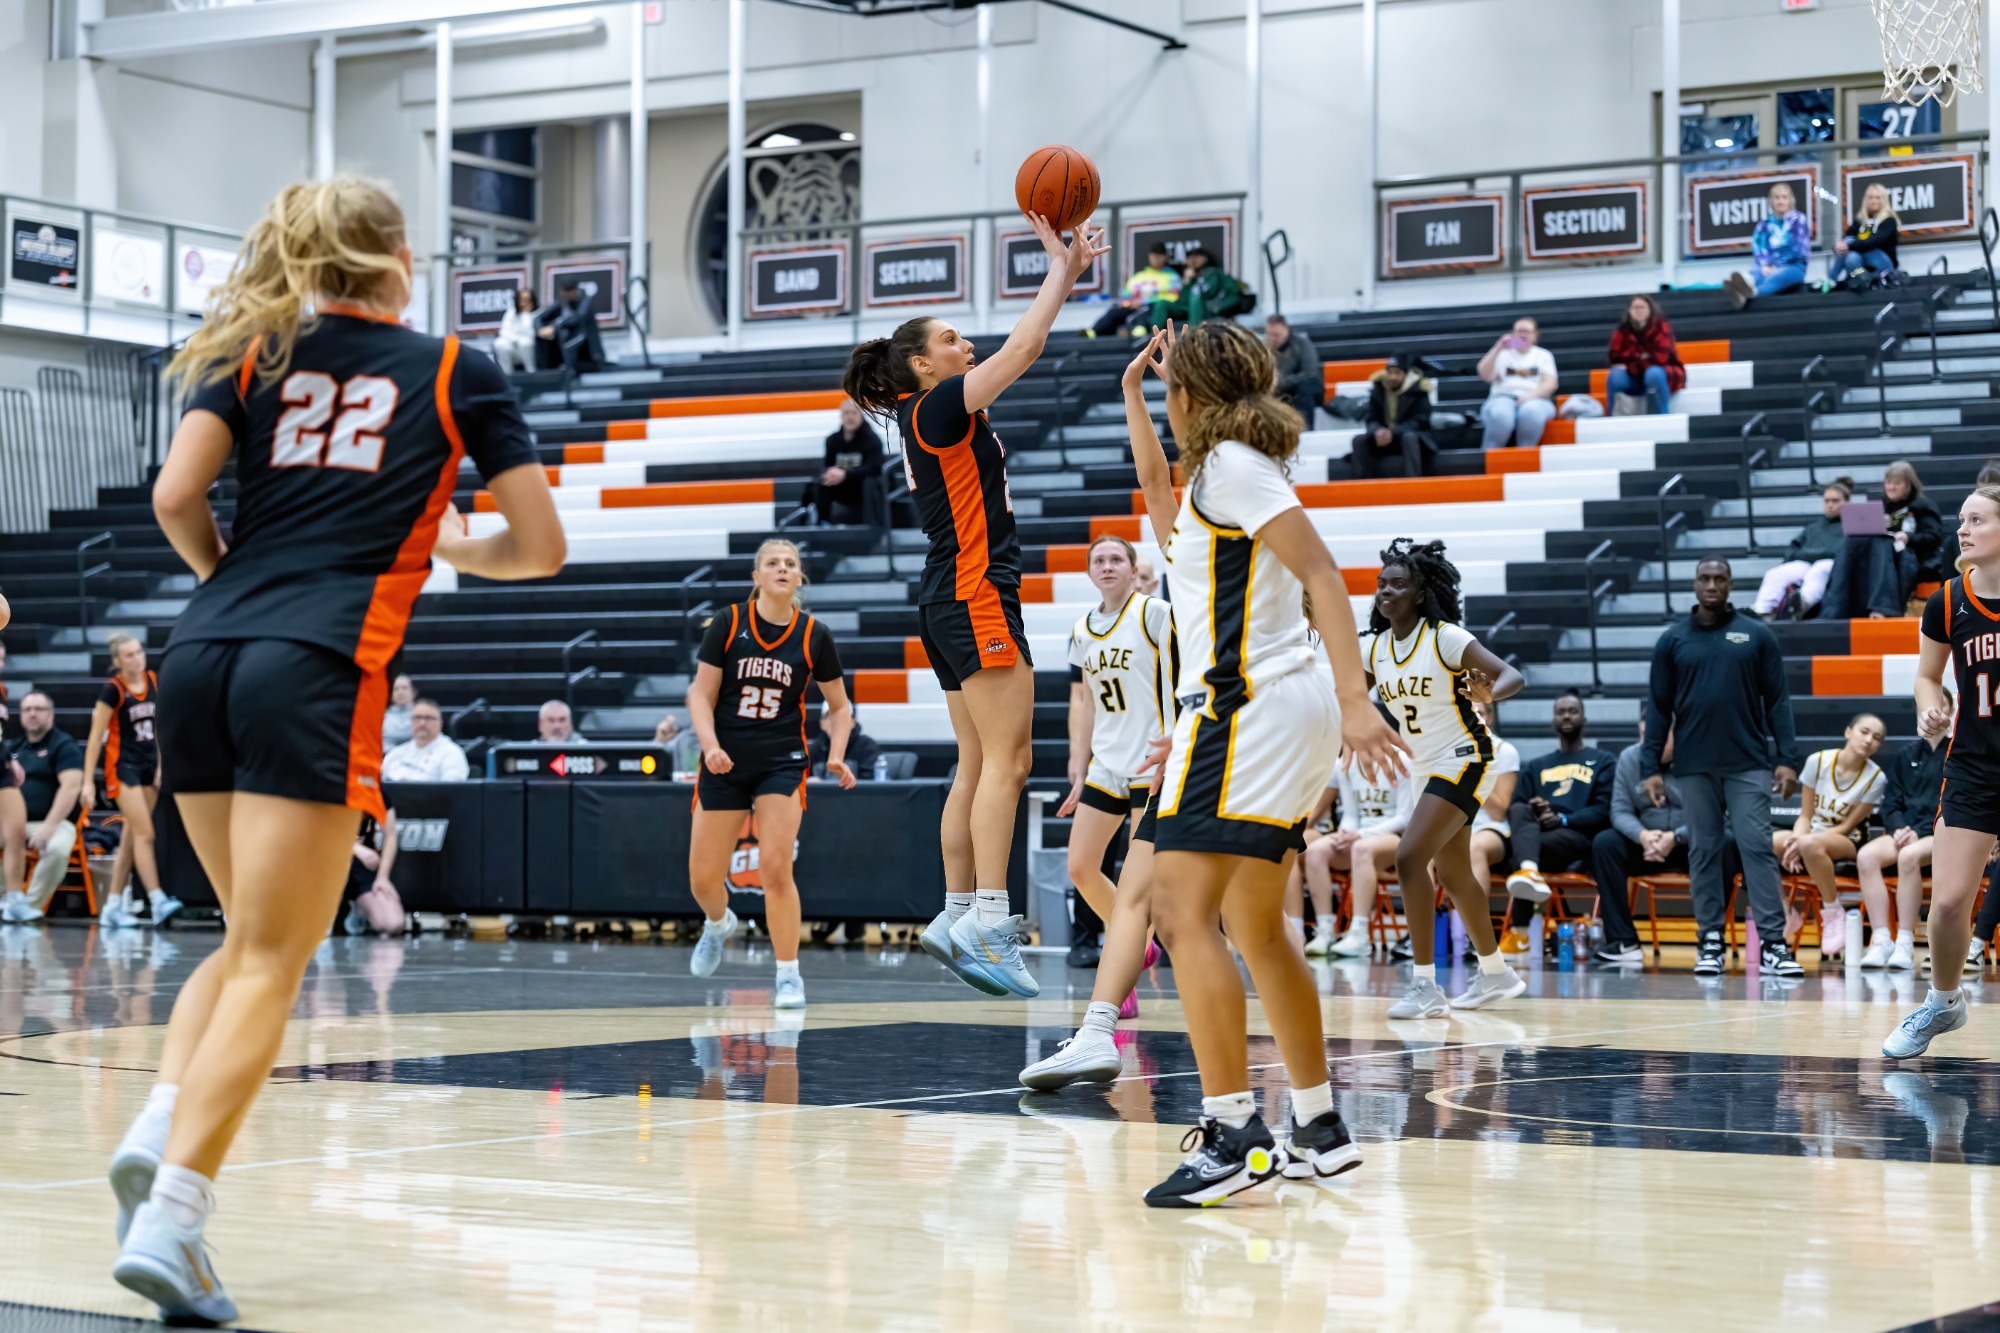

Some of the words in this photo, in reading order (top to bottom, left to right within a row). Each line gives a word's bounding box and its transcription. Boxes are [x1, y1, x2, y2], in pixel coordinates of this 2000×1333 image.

[1882, 106, 1918, 139] 27
[1543, 206, 1626, 237] SECTION
[1709, 196, 1768, 226] VISITI
[1425, 220, 1461, 247] FAN
[879, 257, 948, 286] SECTION
[1013, 251, 1051, 276] VISIT
[774, 267, 820, 294] BAND
[270, 370, 400, 473] 22
[737, 656, 793, 687] TIGERS
[737, 685, 783, 719] 25
[1100, 678, 1127, 713] 21
[1379, 676, 1433, 703] BLAZE
[1403, 704, 1423, 735] 2
[565, 756, 595, 774] POSS
[1355, 788, 1391, 804] LAZE
[1814, 794, 1852, 817] BLAZ
